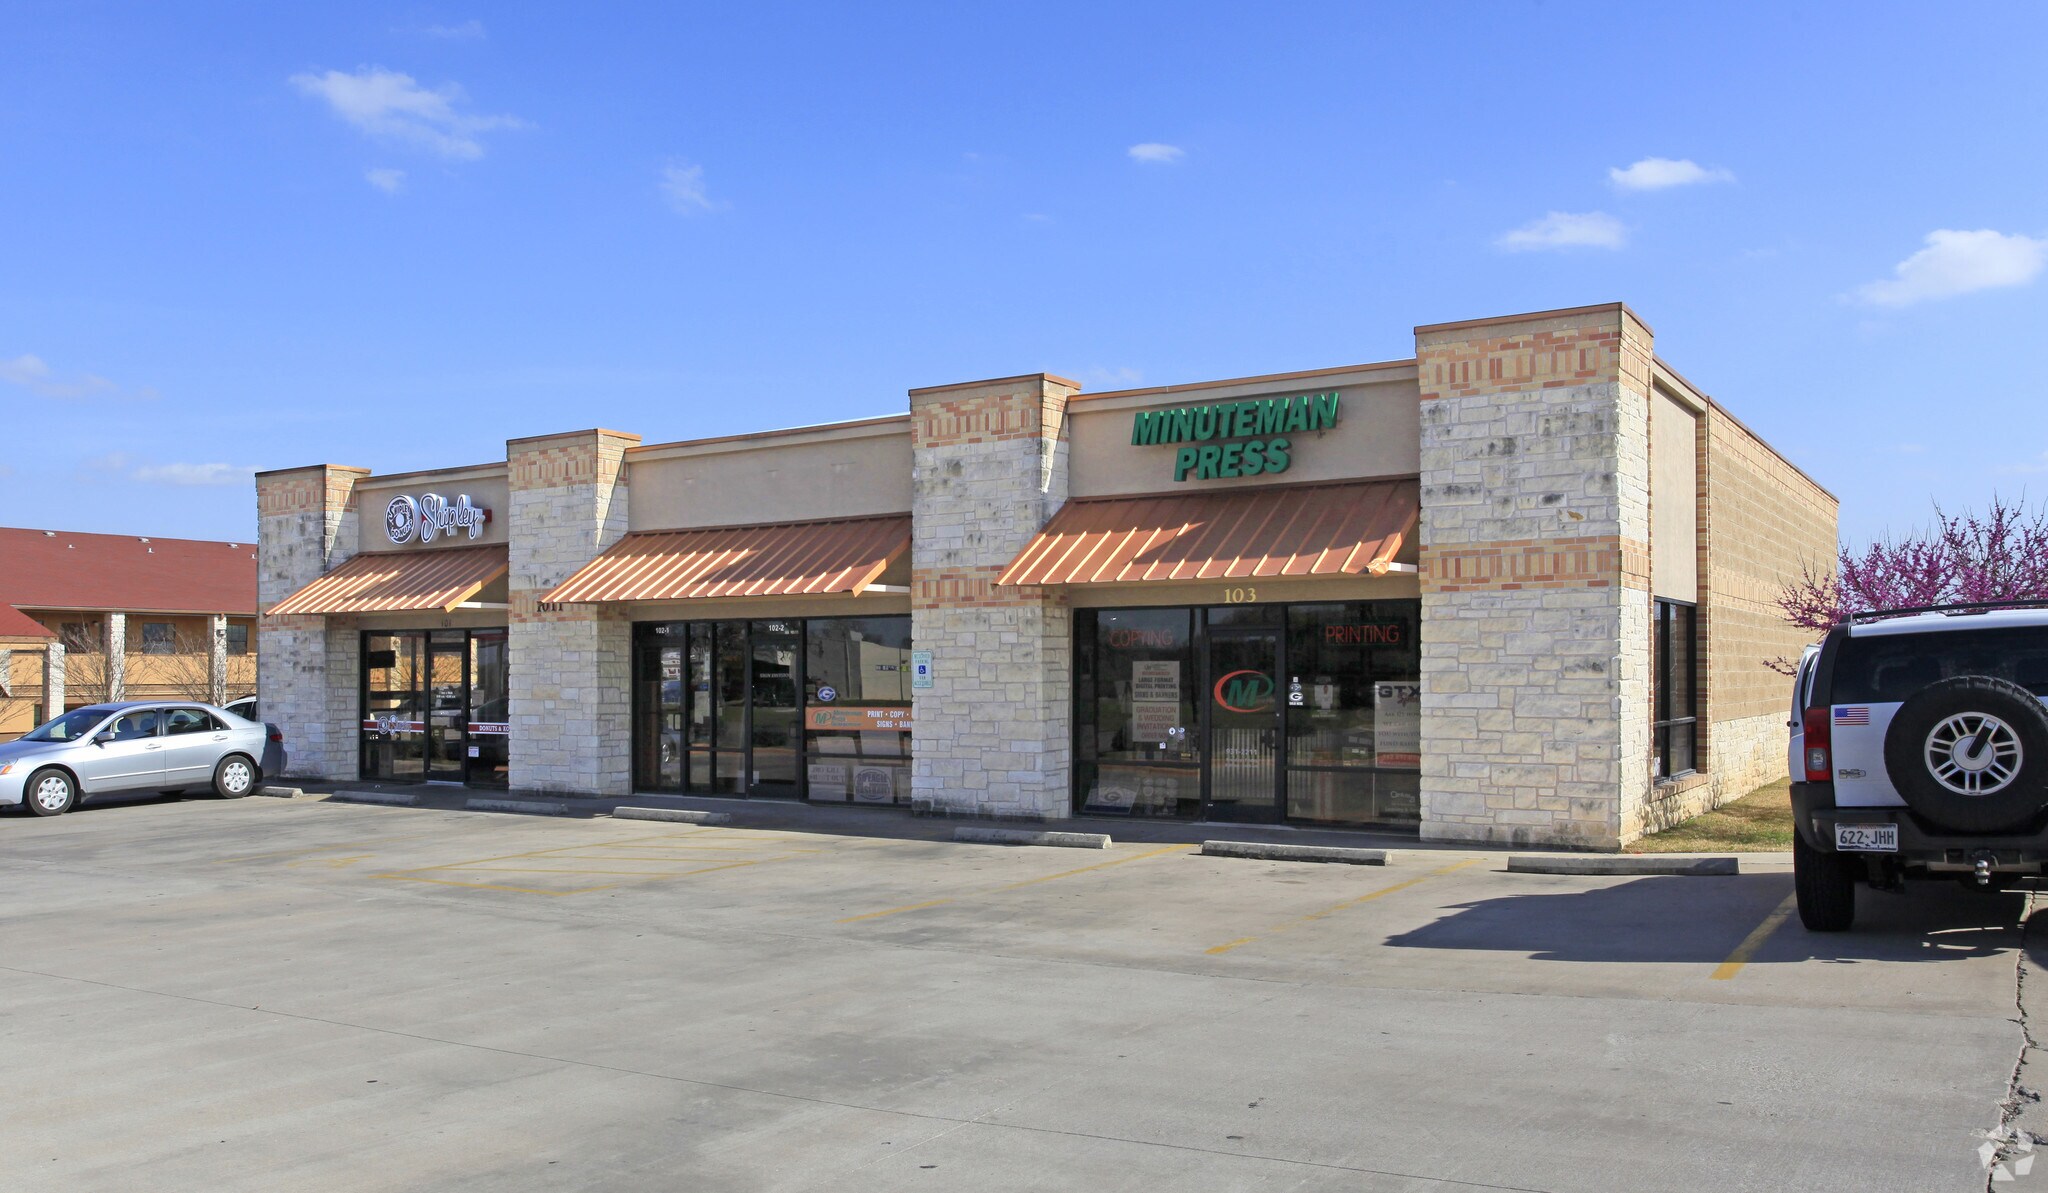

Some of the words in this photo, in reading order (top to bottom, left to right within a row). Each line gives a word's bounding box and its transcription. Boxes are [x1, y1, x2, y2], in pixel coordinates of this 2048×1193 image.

[1131, 393, 1340, 446] MINUTEMAN
[1174, 438, 1292, 482] PRESS
[420, 493, 481, 543] Shipley
[1224, 587, 1257, 603] 103
[768, 624, 785, 632] 102-2
[1325, 624, 1400, 643] PRINTING
[1109, 629, 1173, 648] COPYING
[867, 710, 884, 718] PRINT
[889, 710, 905, 718] COPY
[876, 720, 893, 728] SIGNS
[1840, 830, 1864, 845] 622
[1870, 830, 1894, 845] JHH
